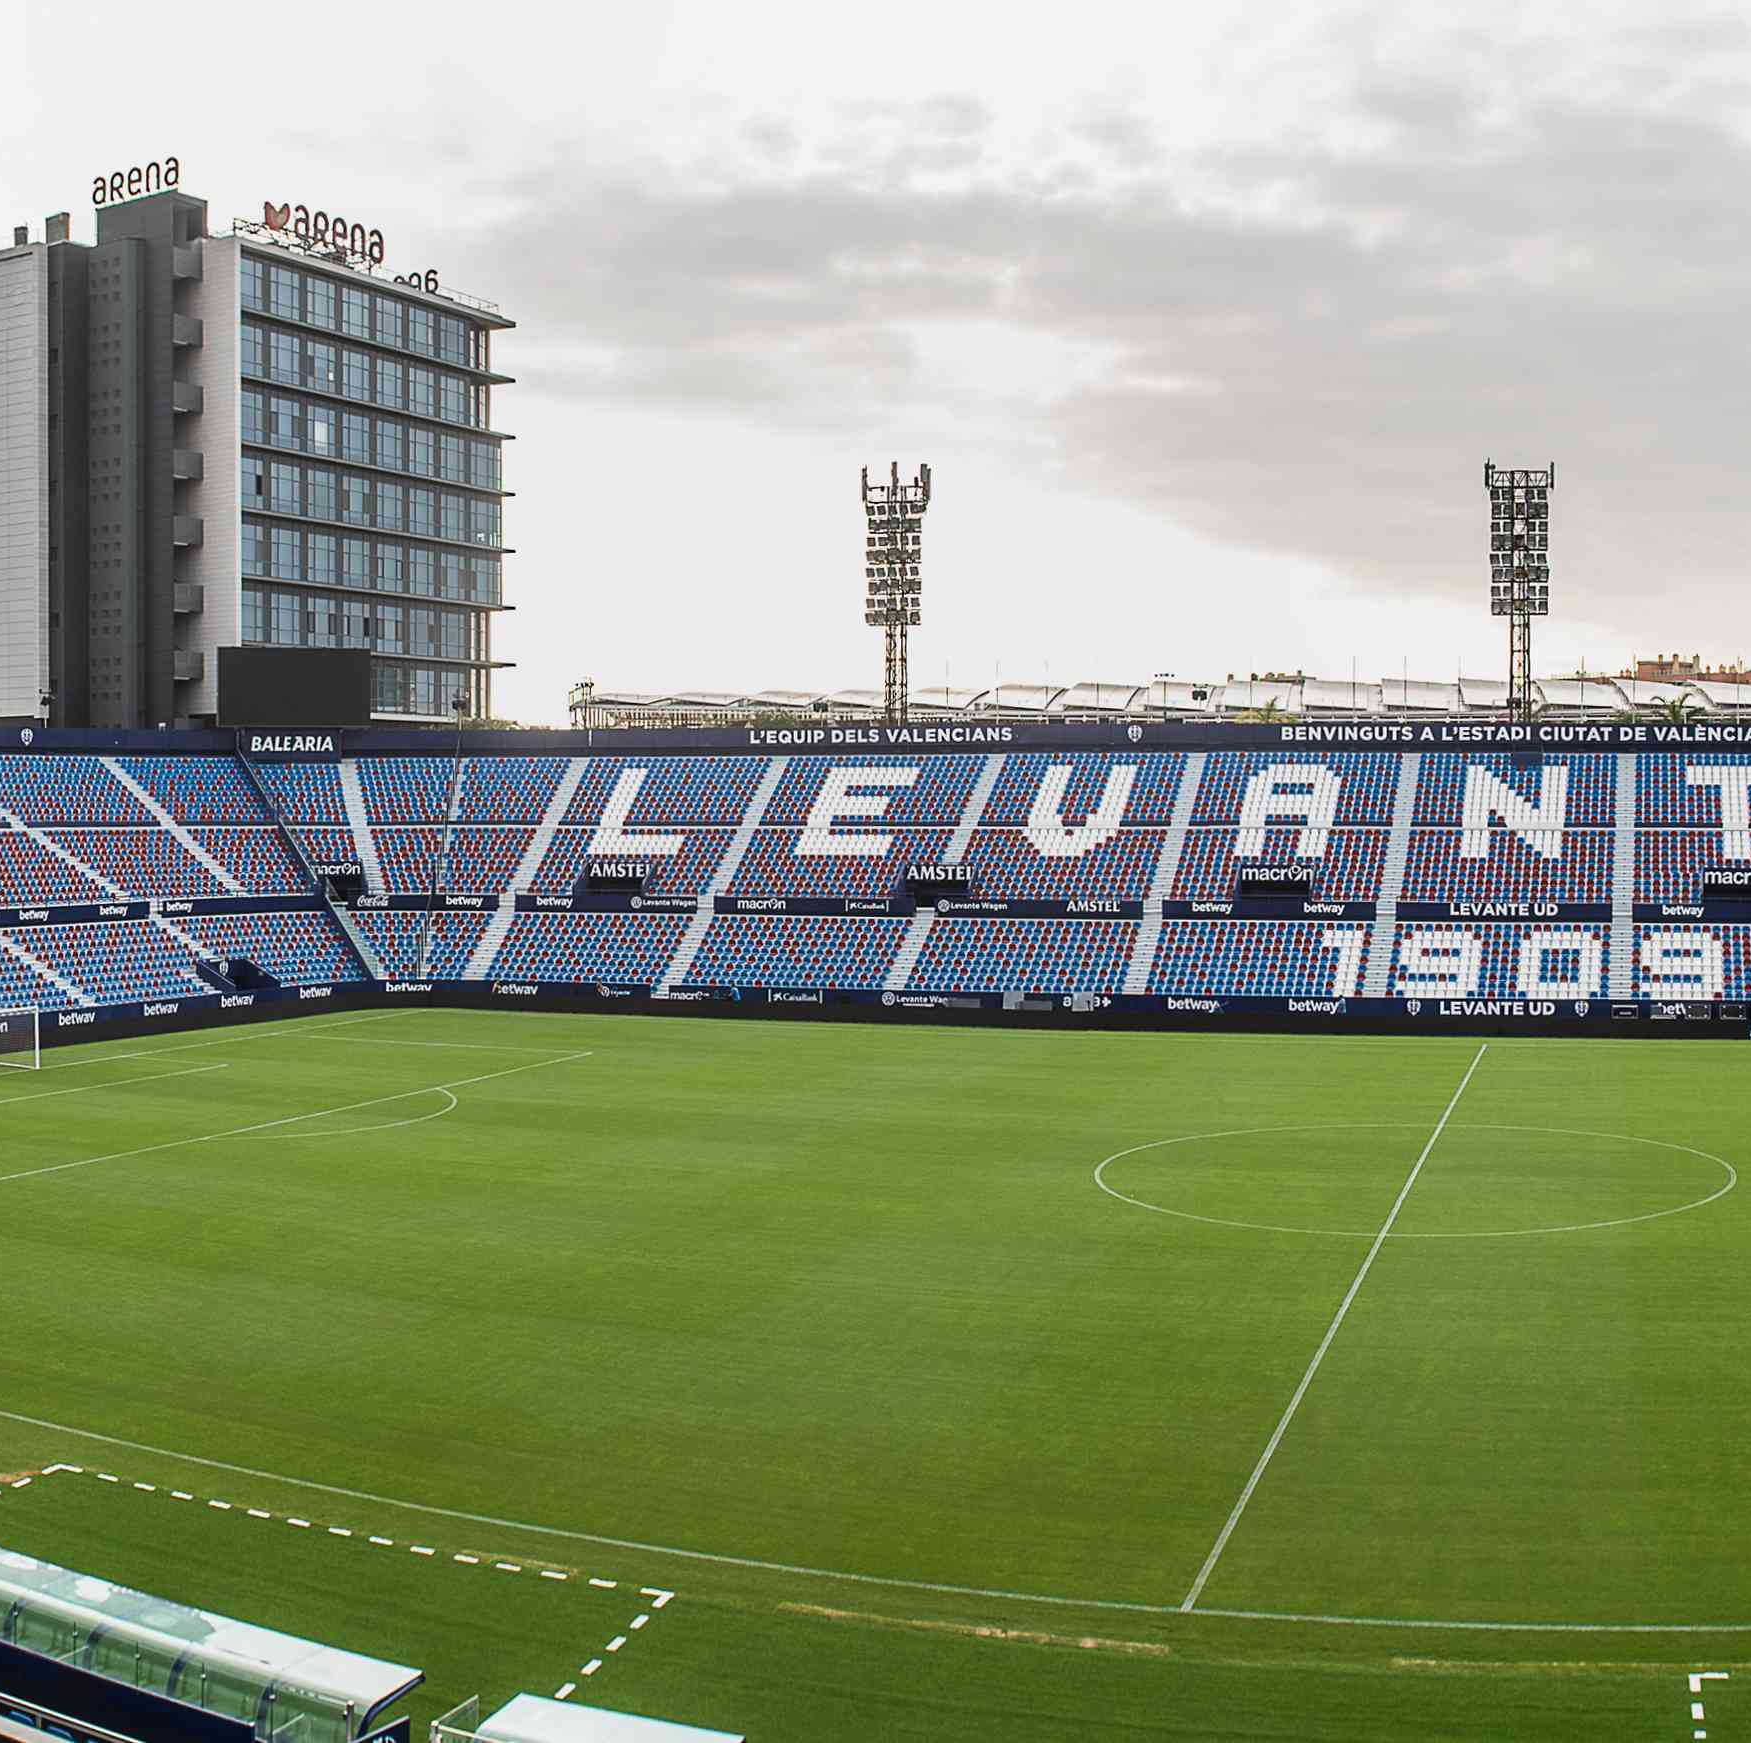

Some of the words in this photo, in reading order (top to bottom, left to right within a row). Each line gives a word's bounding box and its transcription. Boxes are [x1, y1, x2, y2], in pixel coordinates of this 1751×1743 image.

[831, 728, 880, 743] DELS
[886, 727, 1013, 742] VALENCIANS
[1281, 726, 1414, 741] BENVINGUTS
[1420, 727, 1435, 741] A
[1539, 726, 1612, 741] CIUTAT
[1619, 727, 1645, 741] DE
[250, 735, 334, 752] BALEARIA
[1242, 866, 1312, 882] macron
[166, 900, 193, 913] betway
[445, 895, 483, 908] betway
[536, 895, 574, 908] betway
[642, 898, 670, 908] Levante
[672, 898, 697, 909] Wagen
[737, 897, 786, 911] macron
[951, 901, 979, 911] Levante
[981, 901, 1008, 912] Wagen
[1066, 900, 1120, 913] AMSTEL
[1191, 901, 1233, 914] betway
[1303, 901, 1345, 915] betway
[18, 909, 50, 922] betway
[99, 904, 128, 917] betway
[1449, 903, 1529, 917] LEVANTE
[1534, 903, 1558, 917] UD
[1661, 904, 1704, 918] betway
[300, 984, 332, 999] betway
[221, 993, 253, 1009] betway
[896, 994, 931, 1004] Levante
[933, 994, 949, 1005] Wag
[1168, 997, 1217, 1012] betway
[1288, 999, 1338, 1014] betway
[143, 1001, 179, 1016] betway
[1439, 1001, 1525, 1016] LEVANTE
[1530, 1001, 1555, 1016] UD
[58, 1010, 96, 1027] betway
